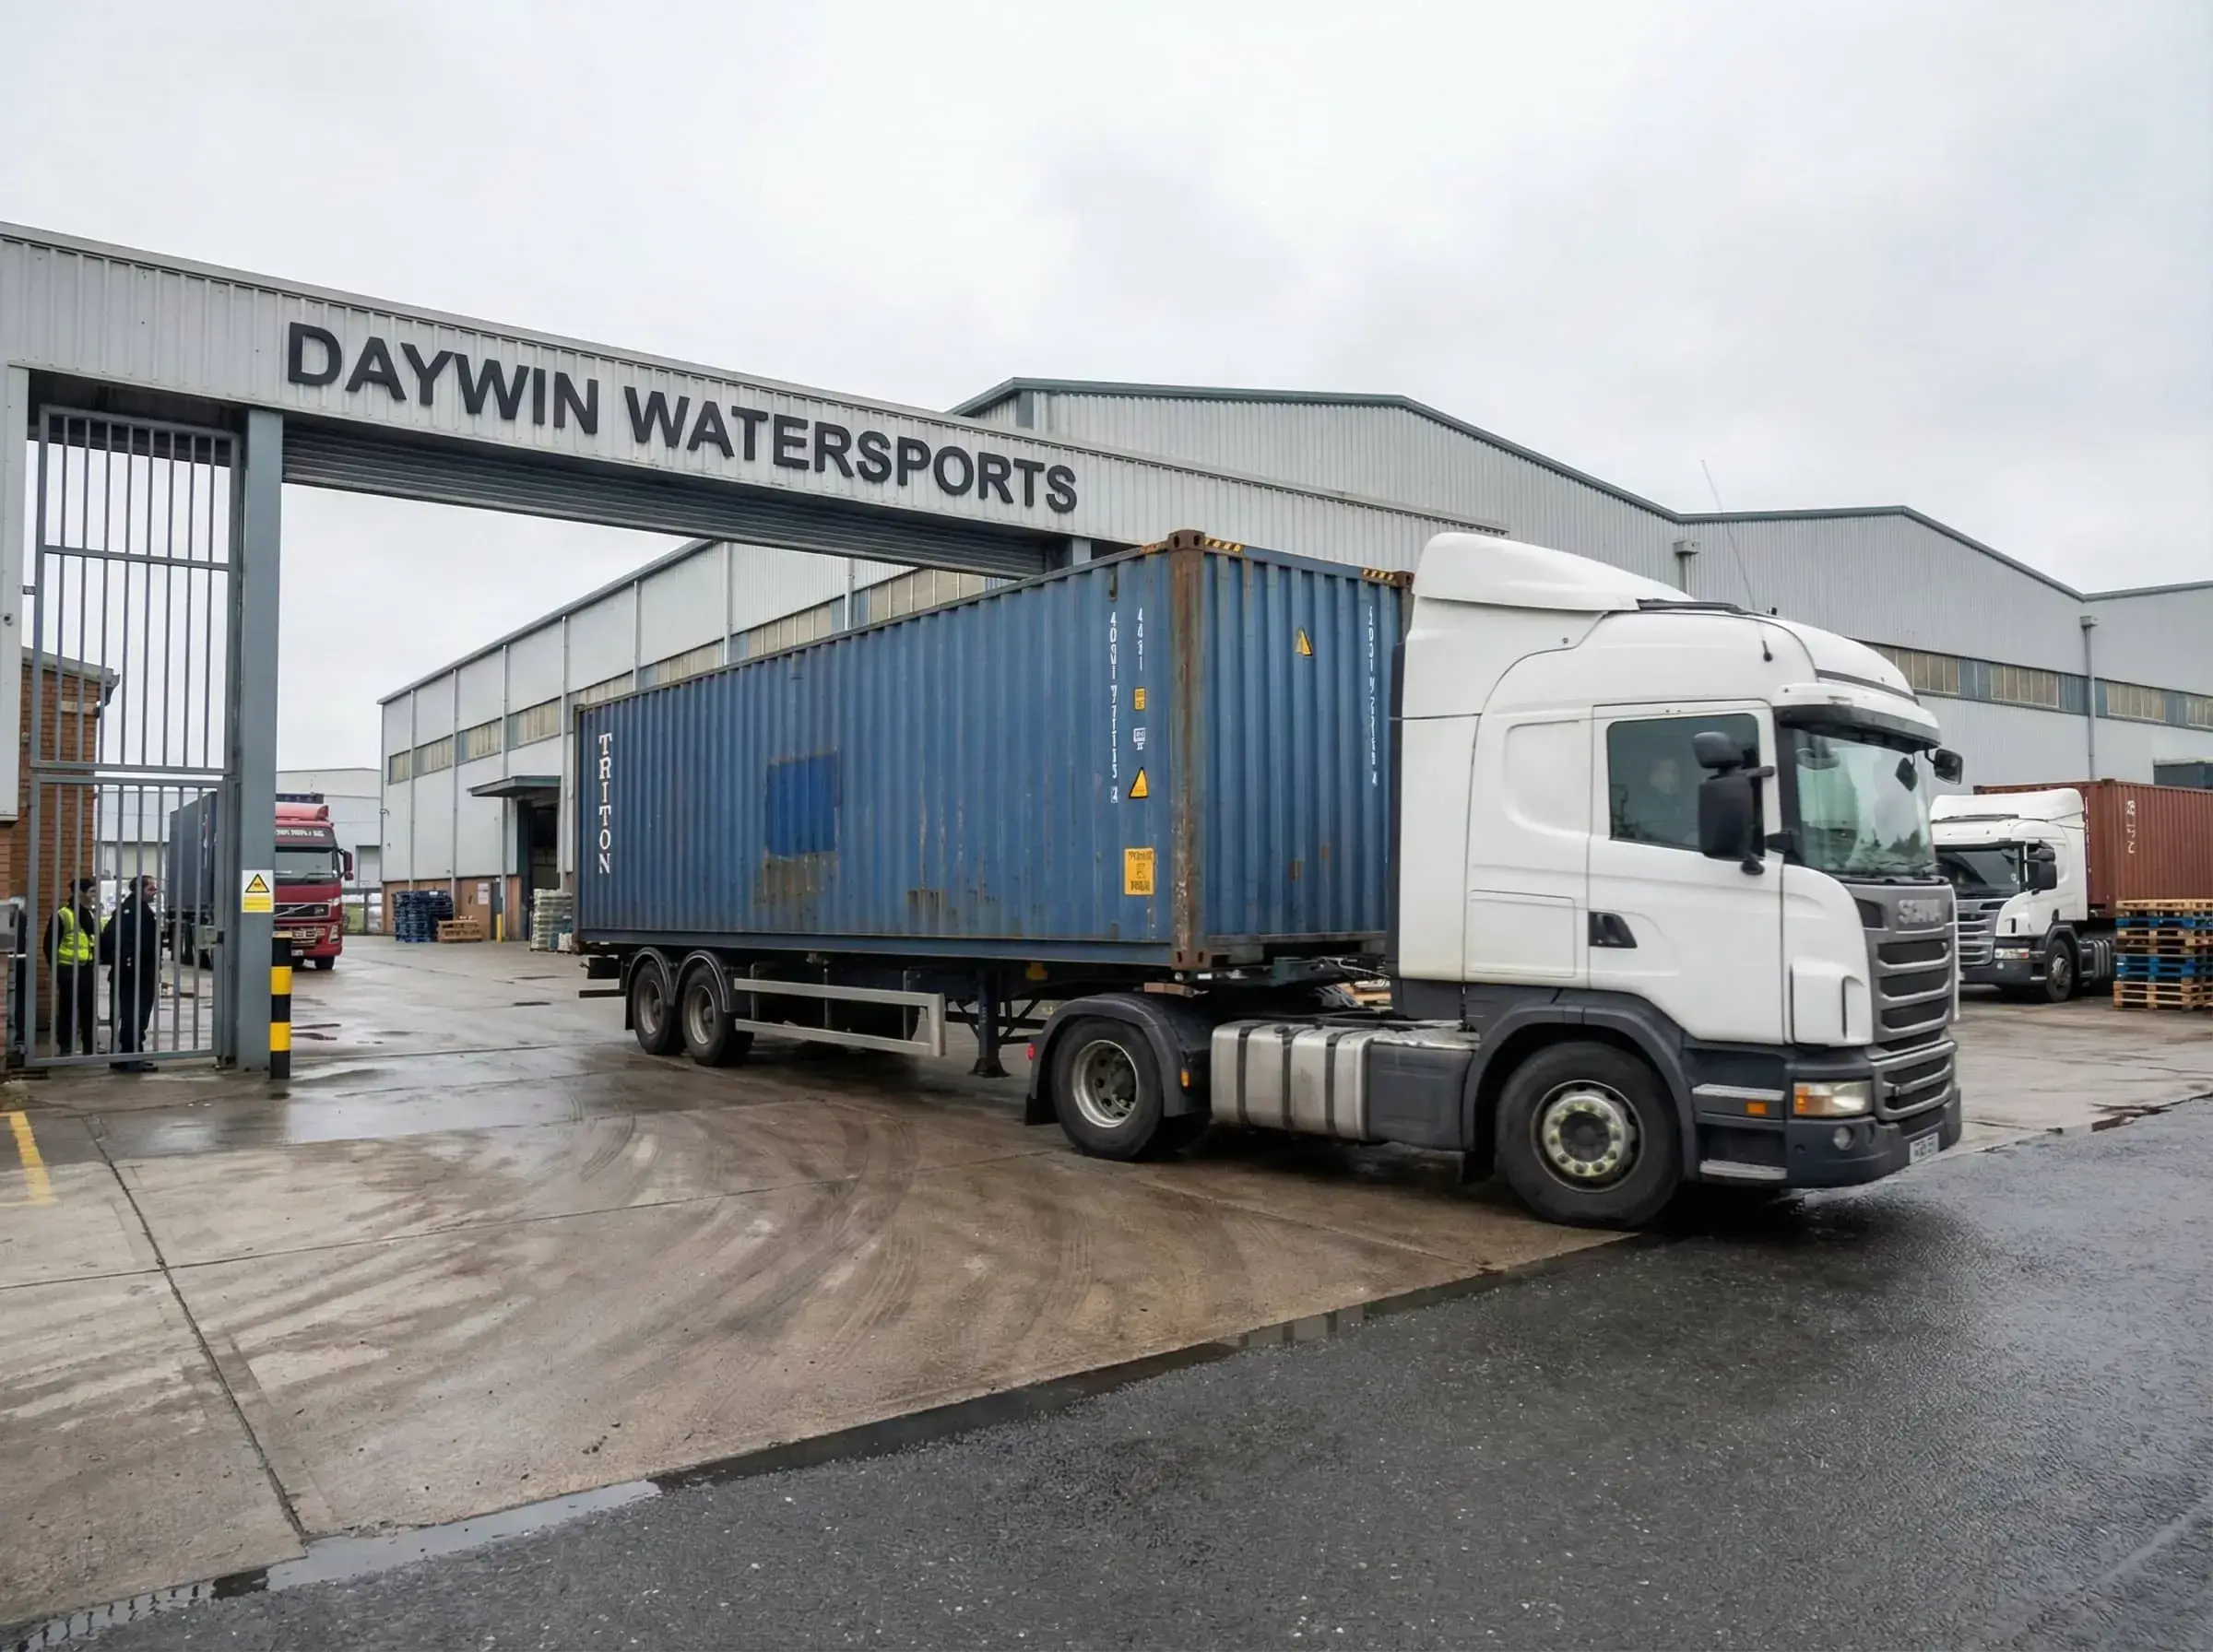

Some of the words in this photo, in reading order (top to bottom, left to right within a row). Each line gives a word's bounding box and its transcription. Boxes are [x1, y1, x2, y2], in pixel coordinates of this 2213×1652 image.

[288, 321, 598, 435] DAYWIN
[624, 385, 1077, 513] WATERSPORTS
[598, 732, 612, 874] TRITON
